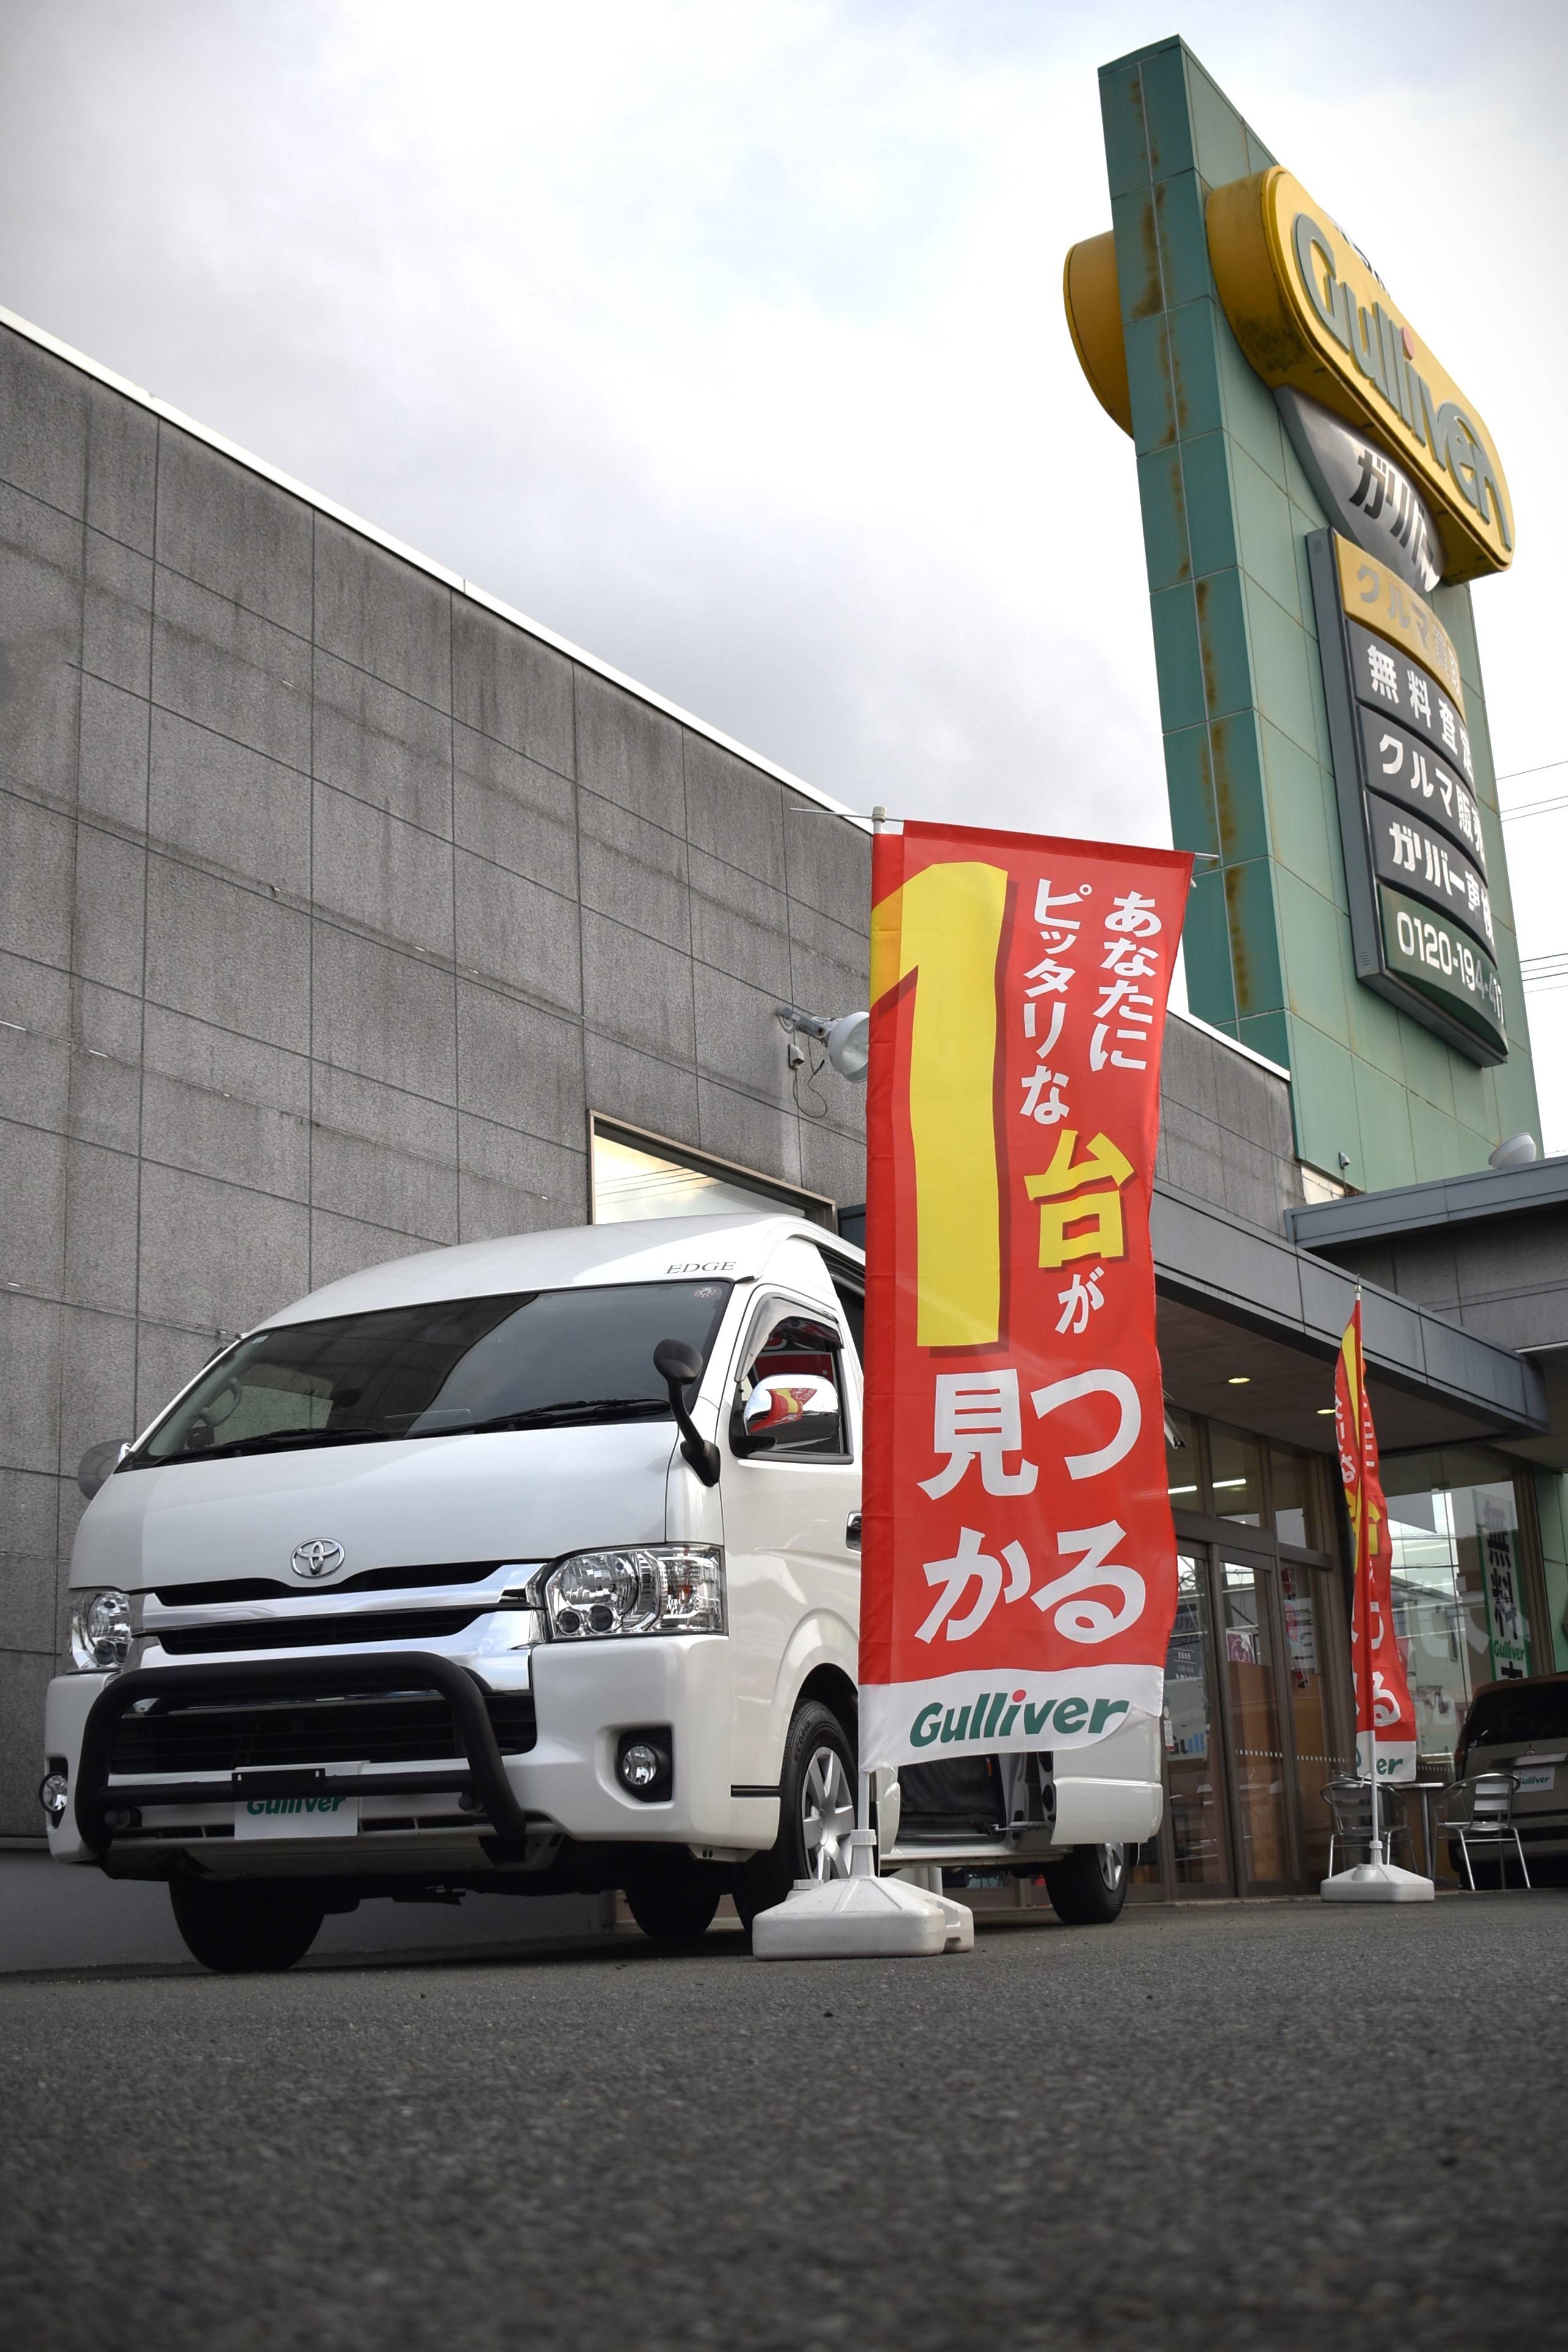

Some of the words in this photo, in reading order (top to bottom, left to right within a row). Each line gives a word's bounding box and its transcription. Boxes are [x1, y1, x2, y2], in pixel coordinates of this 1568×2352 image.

[1292, 212, 1512, 552] Gulliver
[1020, 878, 1093, 1124] ピッタリな
[1089, 891, 1162, 1072] あなたに
[664, 1261, 737, 1275] EDGE
[1494, 1640, 1525, 1662] Gulliver
[909, 1689, 1130, 1748] Gulliver
